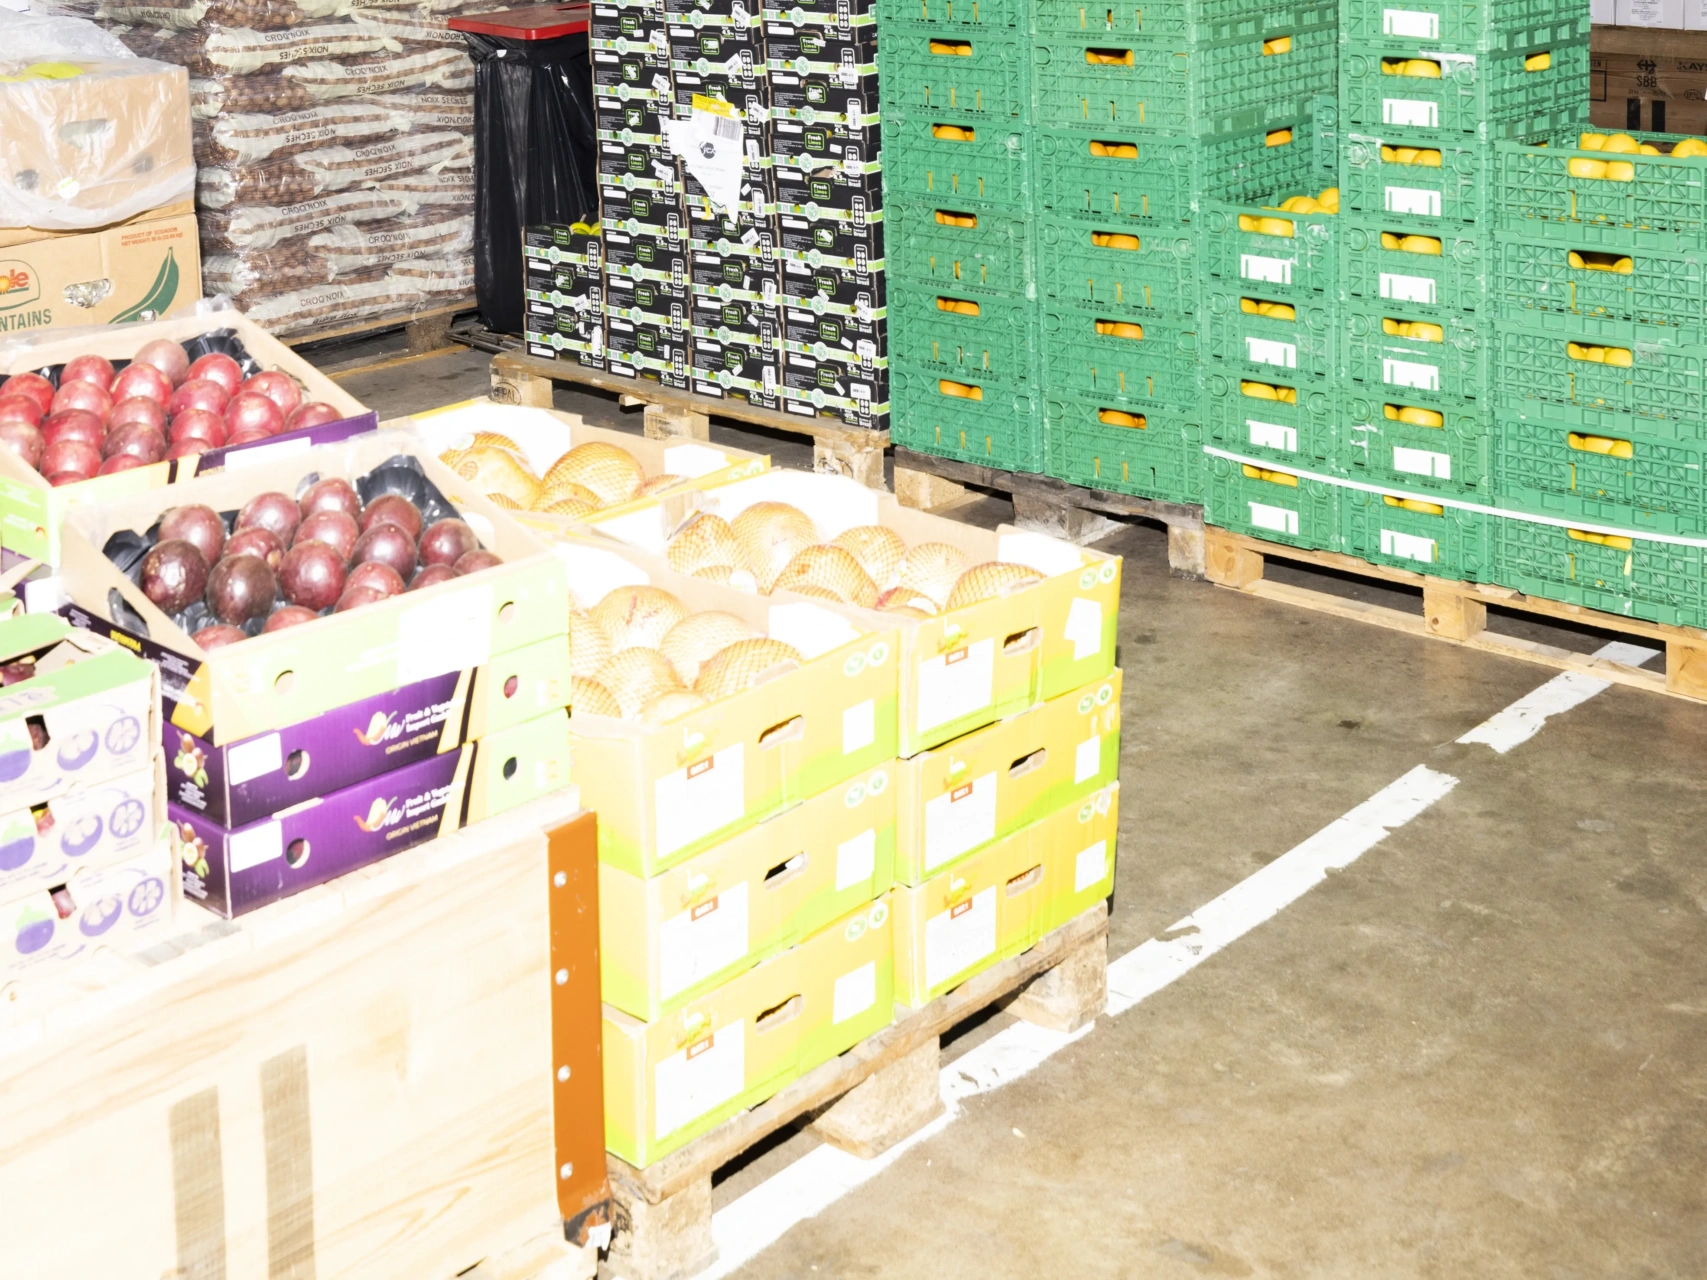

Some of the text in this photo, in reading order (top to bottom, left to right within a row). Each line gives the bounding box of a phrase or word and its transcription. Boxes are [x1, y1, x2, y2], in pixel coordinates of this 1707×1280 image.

[309, 45, 329, 54] NOIX
[357, 80, 405, 93] NOIX SECHES
[1636, 76, 1657, 88] SBB
[364, 161, 413, 176] NOIX SECHES
[281, 200, 328, 216] CROQ'NOIX
[294, 216, 347, 232] NOIX SECHES
[405, 250, 425, 258] NOIX
[300, 291, 344, 306] CROQ'NOIX
[410, 730, 438, 746] VIETNAM
[410, 814, 438, 830] VIETNAM
